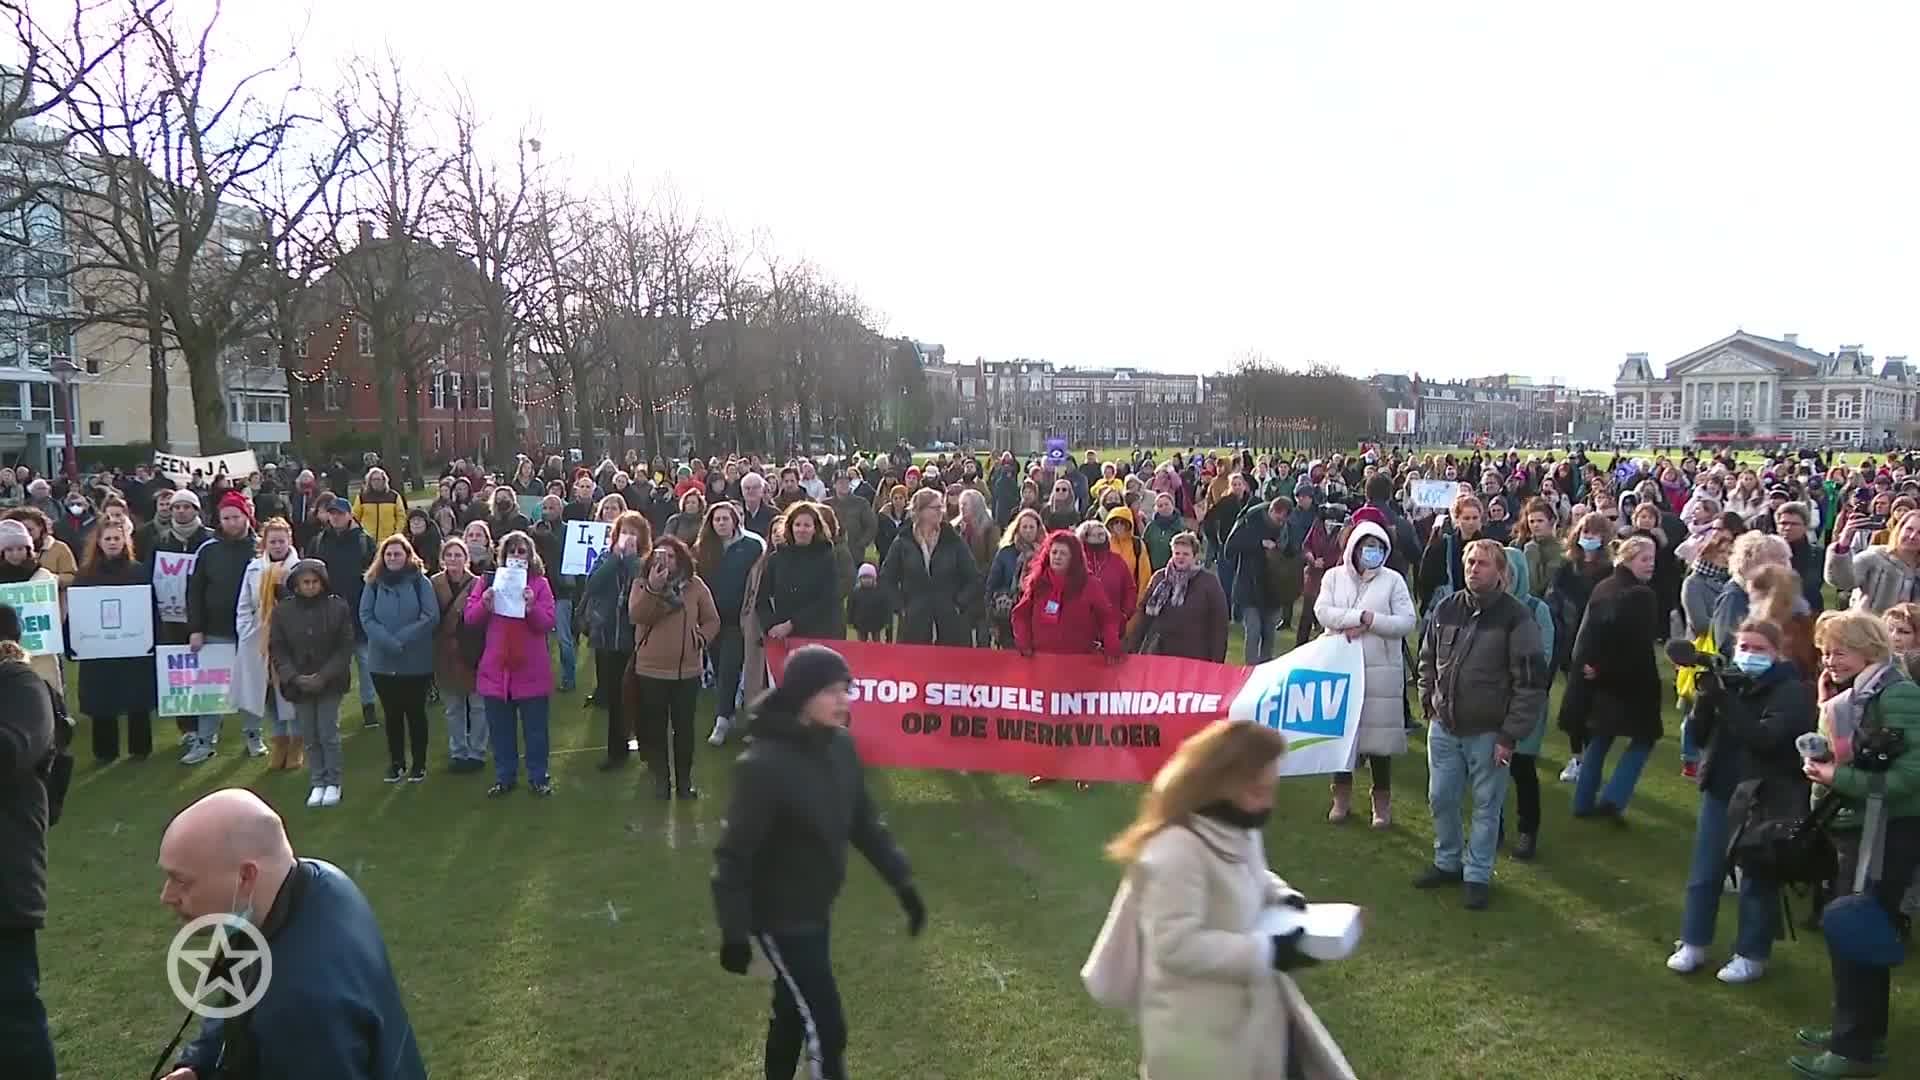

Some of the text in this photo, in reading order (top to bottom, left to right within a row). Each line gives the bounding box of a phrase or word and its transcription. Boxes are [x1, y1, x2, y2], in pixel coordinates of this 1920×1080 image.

[204, 459, 230, 476] JA
[167, 653, 199, 670] NO
[848, 678, 1222, 716] STOP SEKSUELE INTIMIDATIE
[1258, 677, 1349, 729] FNV
[901, 711, 1161, 748] OP DE WERKVLOER
